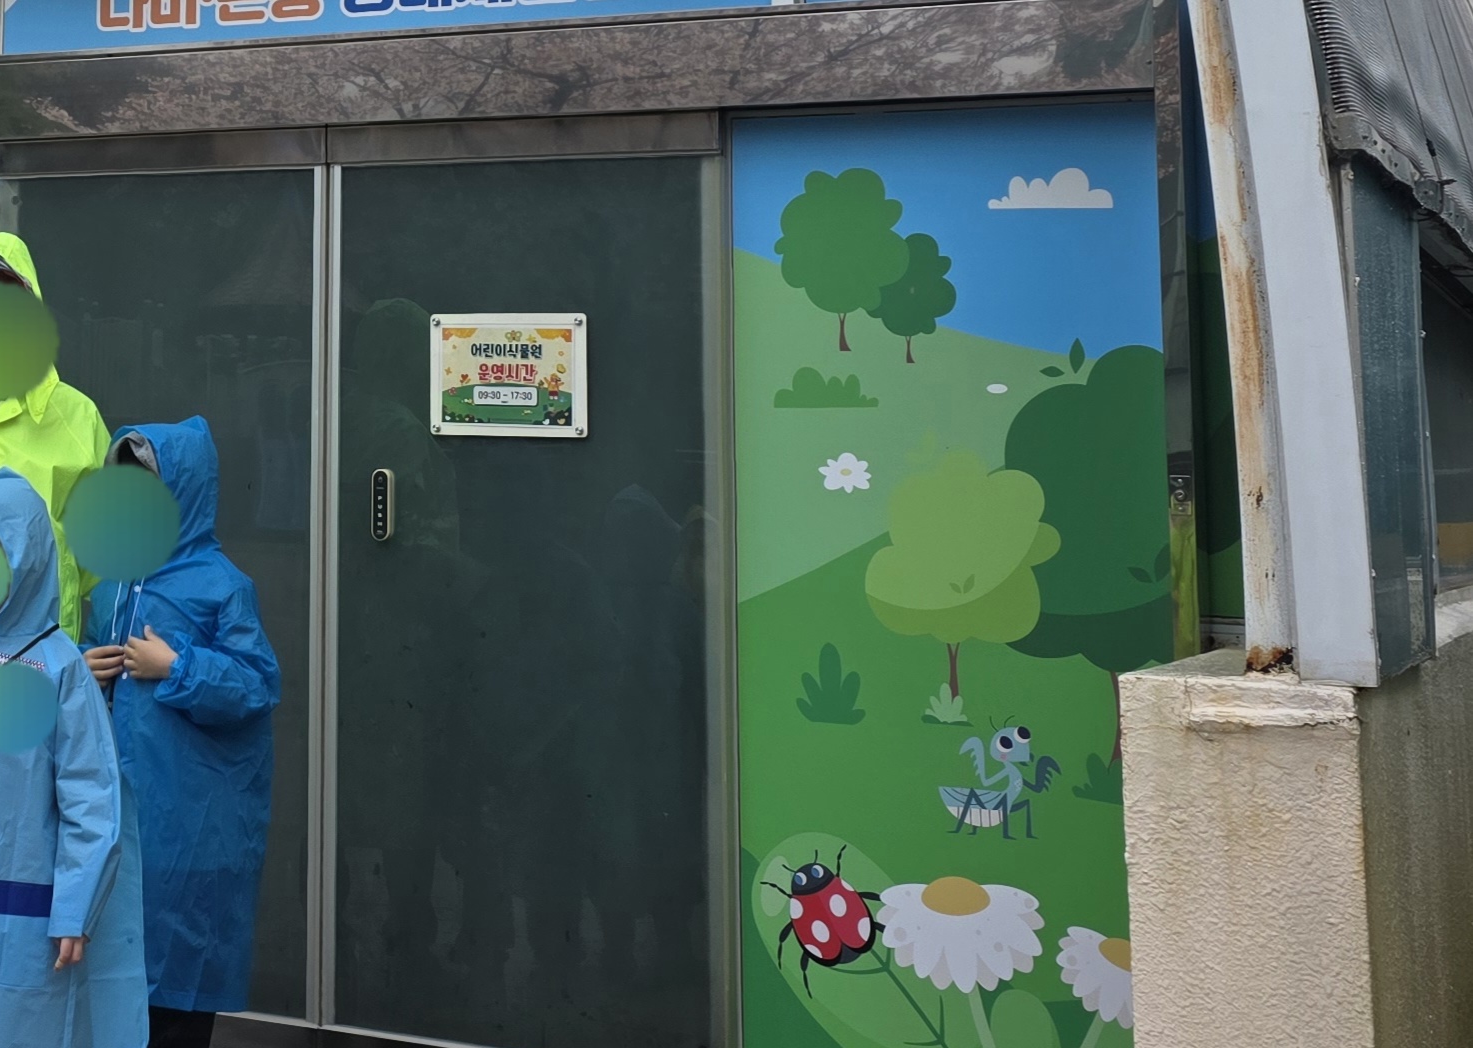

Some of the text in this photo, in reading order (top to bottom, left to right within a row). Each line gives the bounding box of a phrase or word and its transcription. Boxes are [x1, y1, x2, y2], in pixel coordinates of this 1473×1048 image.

[470, 343, 543, 359] 어린이식물원
[477, 363, 538, 383] 운영시간
[478, 391, 501, 400] 09:30
[511, 391, 533, 401] 17:30
